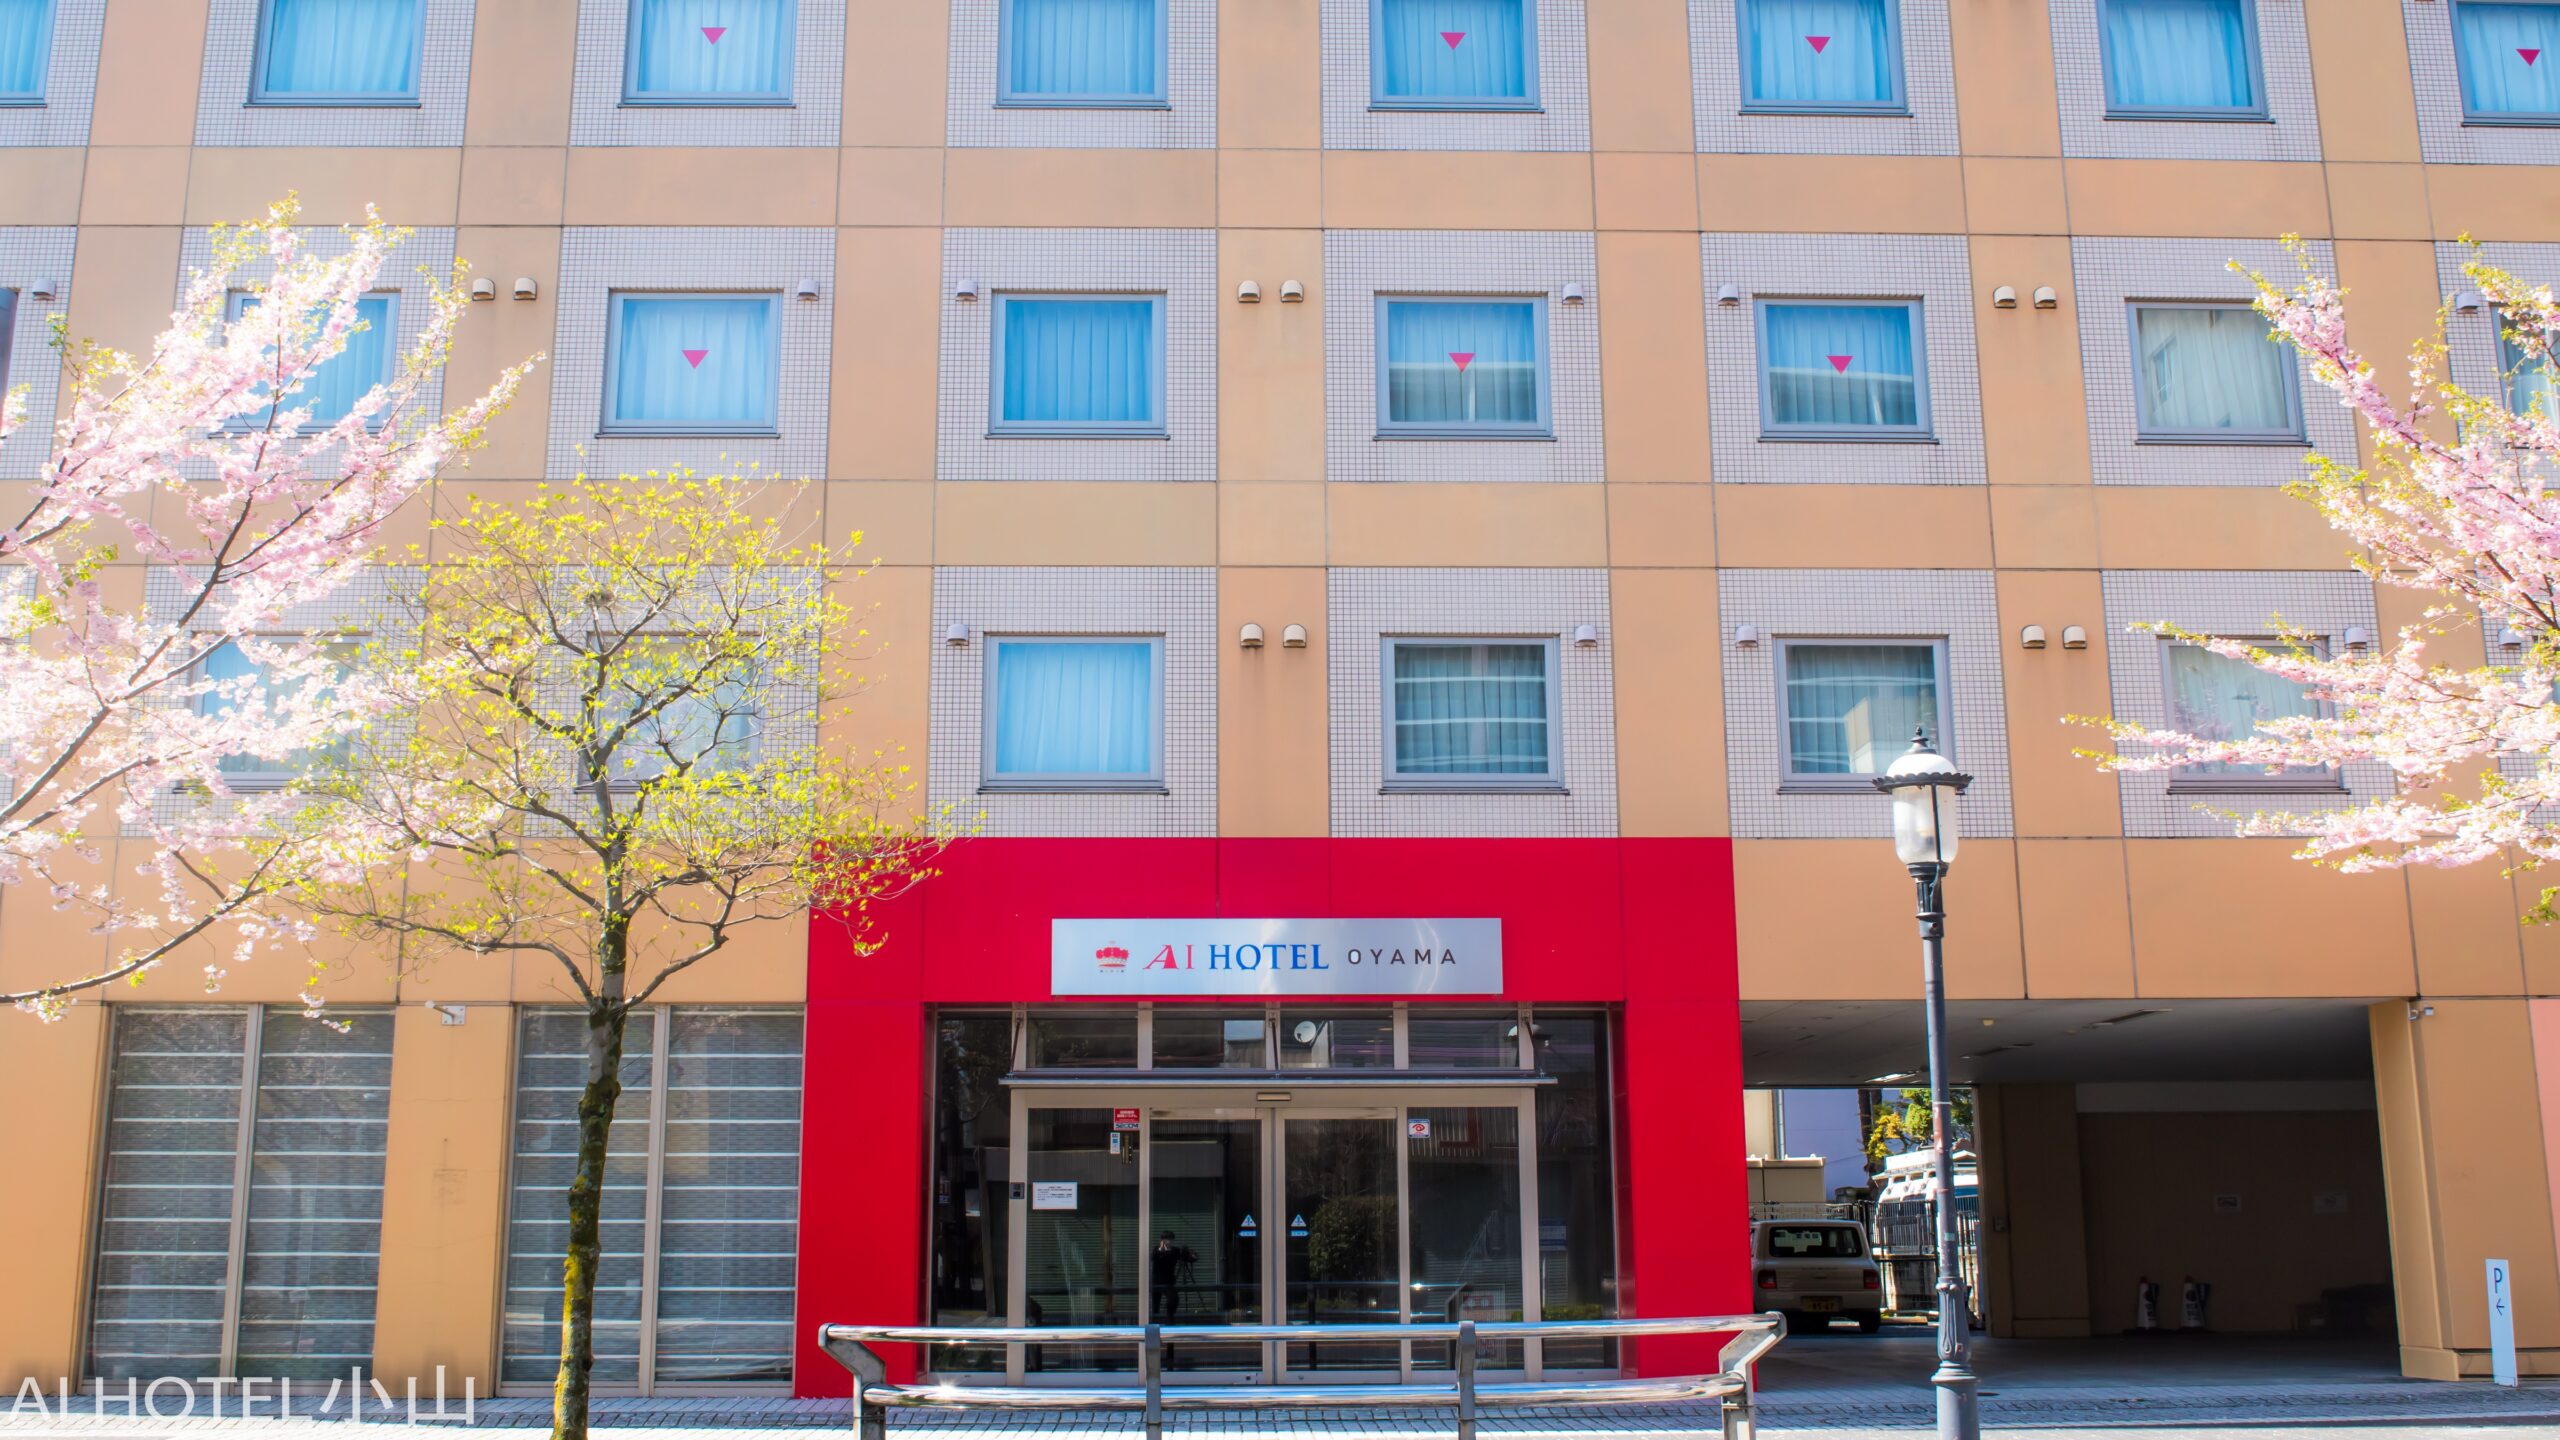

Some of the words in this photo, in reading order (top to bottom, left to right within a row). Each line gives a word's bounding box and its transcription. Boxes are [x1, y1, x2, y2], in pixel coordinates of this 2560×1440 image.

[1142, 944, 1193, 970] AI
[1209, 944, 1329, 971] HOTEL
[1347, 948, 1456, 965] OYAMA
[2493, 1267, 2503, 1294] P
